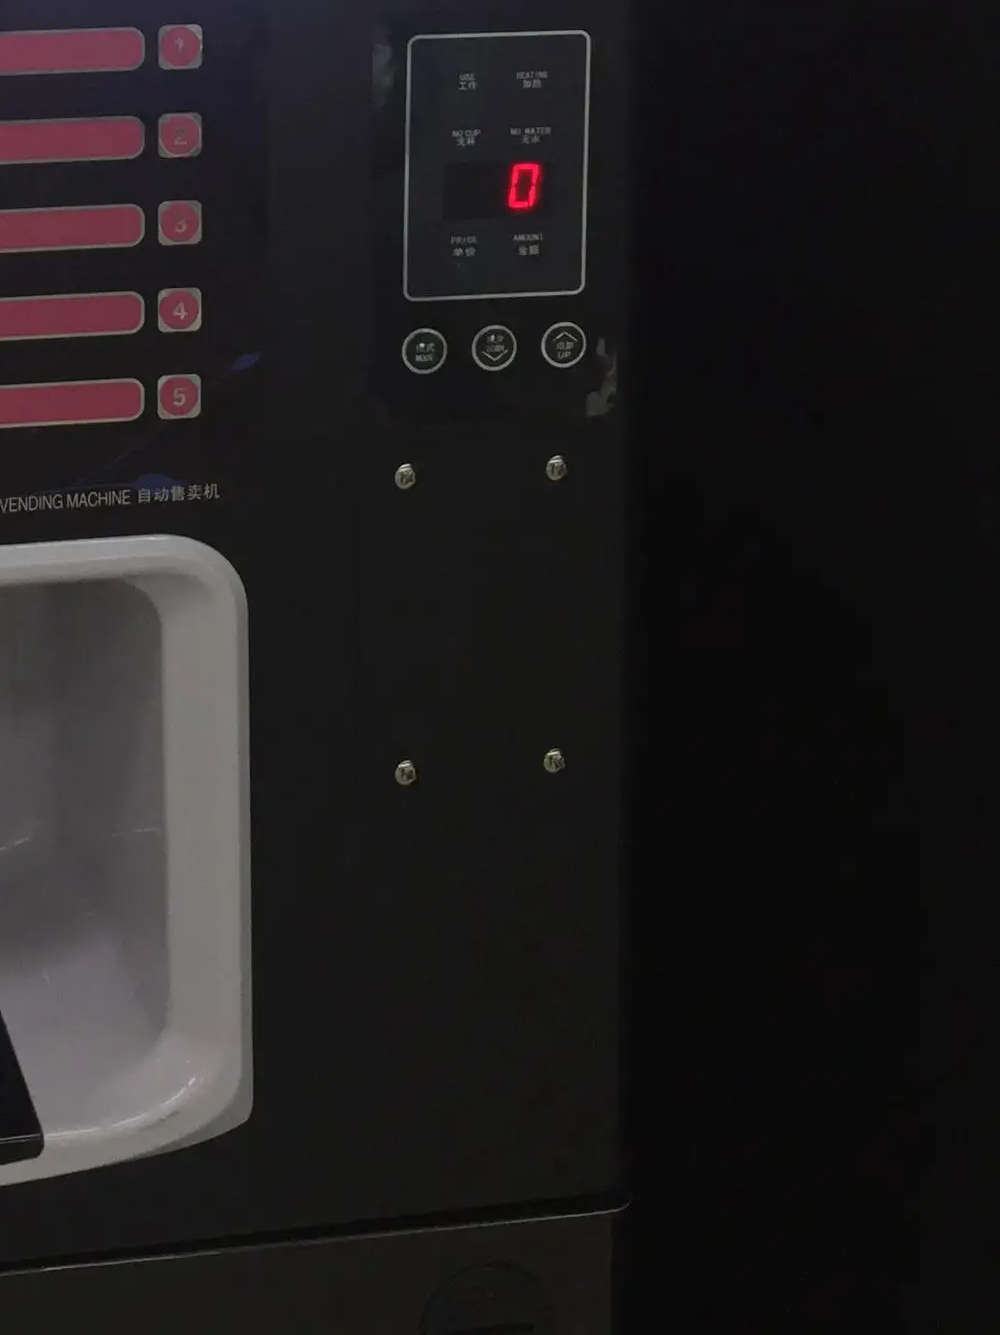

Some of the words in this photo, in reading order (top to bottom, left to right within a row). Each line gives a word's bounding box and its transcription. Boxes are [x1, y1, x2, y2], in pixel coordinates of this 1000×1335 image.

[174, 127, 188, 146] 2
[508, 162, 540, 209] 0
[175, 214, 188, 233] 3
[173, 301, 188, 320] 4
[557, 351, 572, 360] UP
[173, 387, 187, 406] 5
[0, 494, 63, 513] VENDING
[66, 489, 131, 509] MACHINE
[138, 483, 220, 504] 自动售卖机
